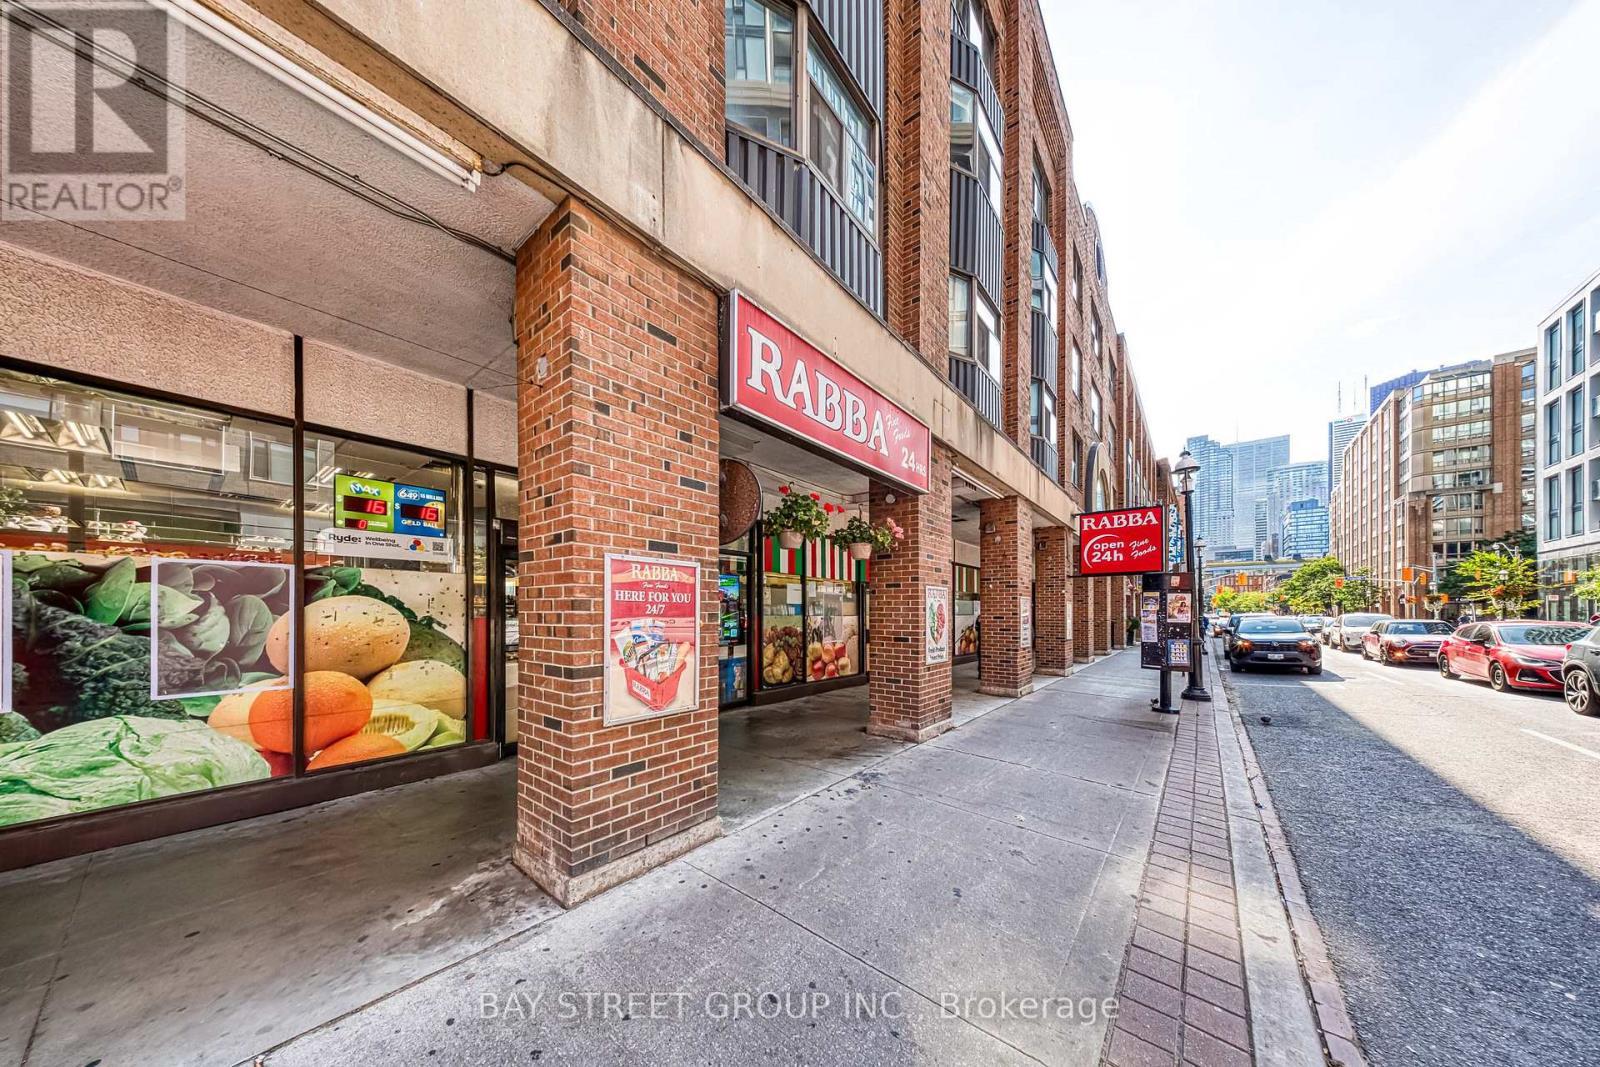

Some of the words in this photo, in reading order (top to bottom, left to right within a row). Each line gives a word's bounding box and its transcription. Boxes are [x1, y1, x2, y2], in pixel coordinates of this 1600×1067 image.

[746, 324, 889, 457] RABBA
[366, 499, 386, 514] 16
[420, 507, 437, 520] 16
[1082, 511, 1159, 531] RABBA
[1093, 541, 1125, 552] open
[1129, 538, 1150, 551] Fine
[1091, 550, 1124, 563] 24h
[1130, 545, 1157, 560] Foods
[631, 563, 679, 581] RABBA
[614, 589, 646, 602] HERE
[648, 591, 669, 603] FOR
[671, 593, 692, 604] YOU
[645, 604, 666, 615] 24/7
